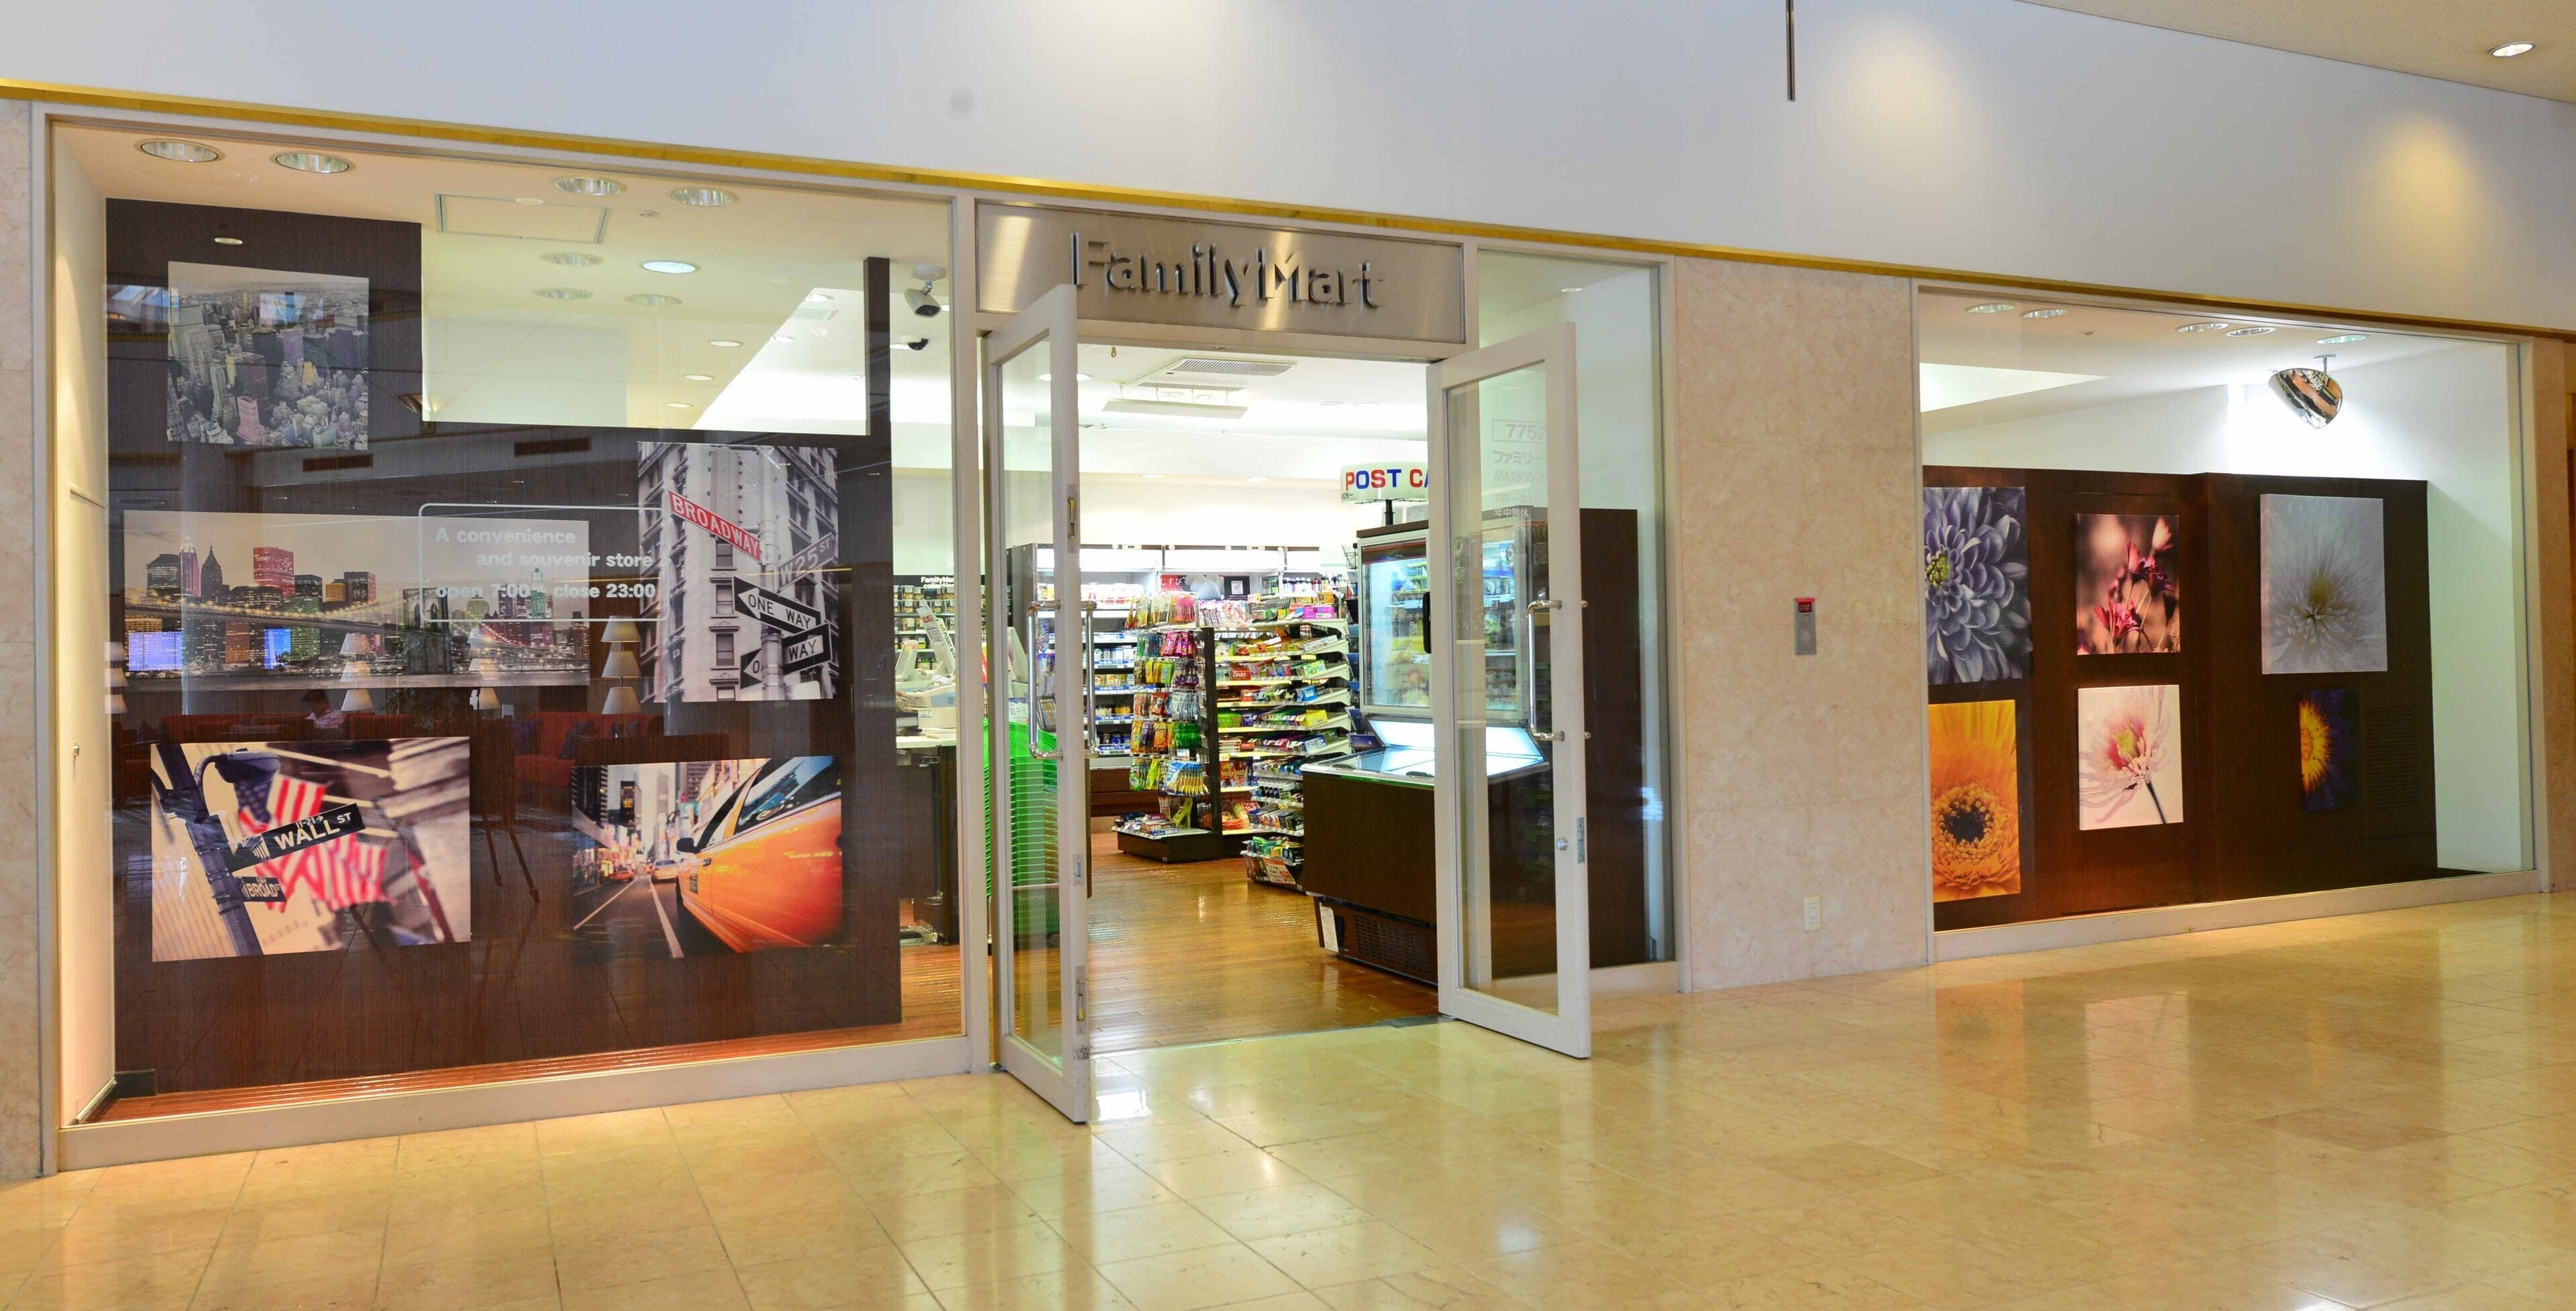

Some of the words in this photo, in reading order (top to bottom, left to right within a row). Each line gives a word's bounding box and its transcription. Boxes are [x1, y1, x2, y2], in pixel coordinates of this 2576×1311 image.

[1070, 231, 1386, 307] FamilyMart
[1345, 468, 1402, 491] POST
[435, 527, 449, 543] A
[457, 528, 576, 544] convenience
[672, 496, 759, 558] BROADWAY
[477, 551, 513, 567] and
[519, 552, 601, 568] souvenir
[605, 552, 653, 568] store
[780, 563, 793, 586] W
[796, 545, 818, 578] 25
[819, 537, 830, 553] ST
[436, 585, 483, 602] open
[490, 582, 531, 598] 7:00
[553, 582, 600, 598] close
[606, 582, 655, 598] 23:00
[748, 594, 774, 616] ONE
[786, 608, 812, 629] WAY
[789, 638, 818, 662] WAY
[273, 819, 341, 851] WALL
[337, 812, 352, 824] ST
[246, 882, 278, 897] BROAD
